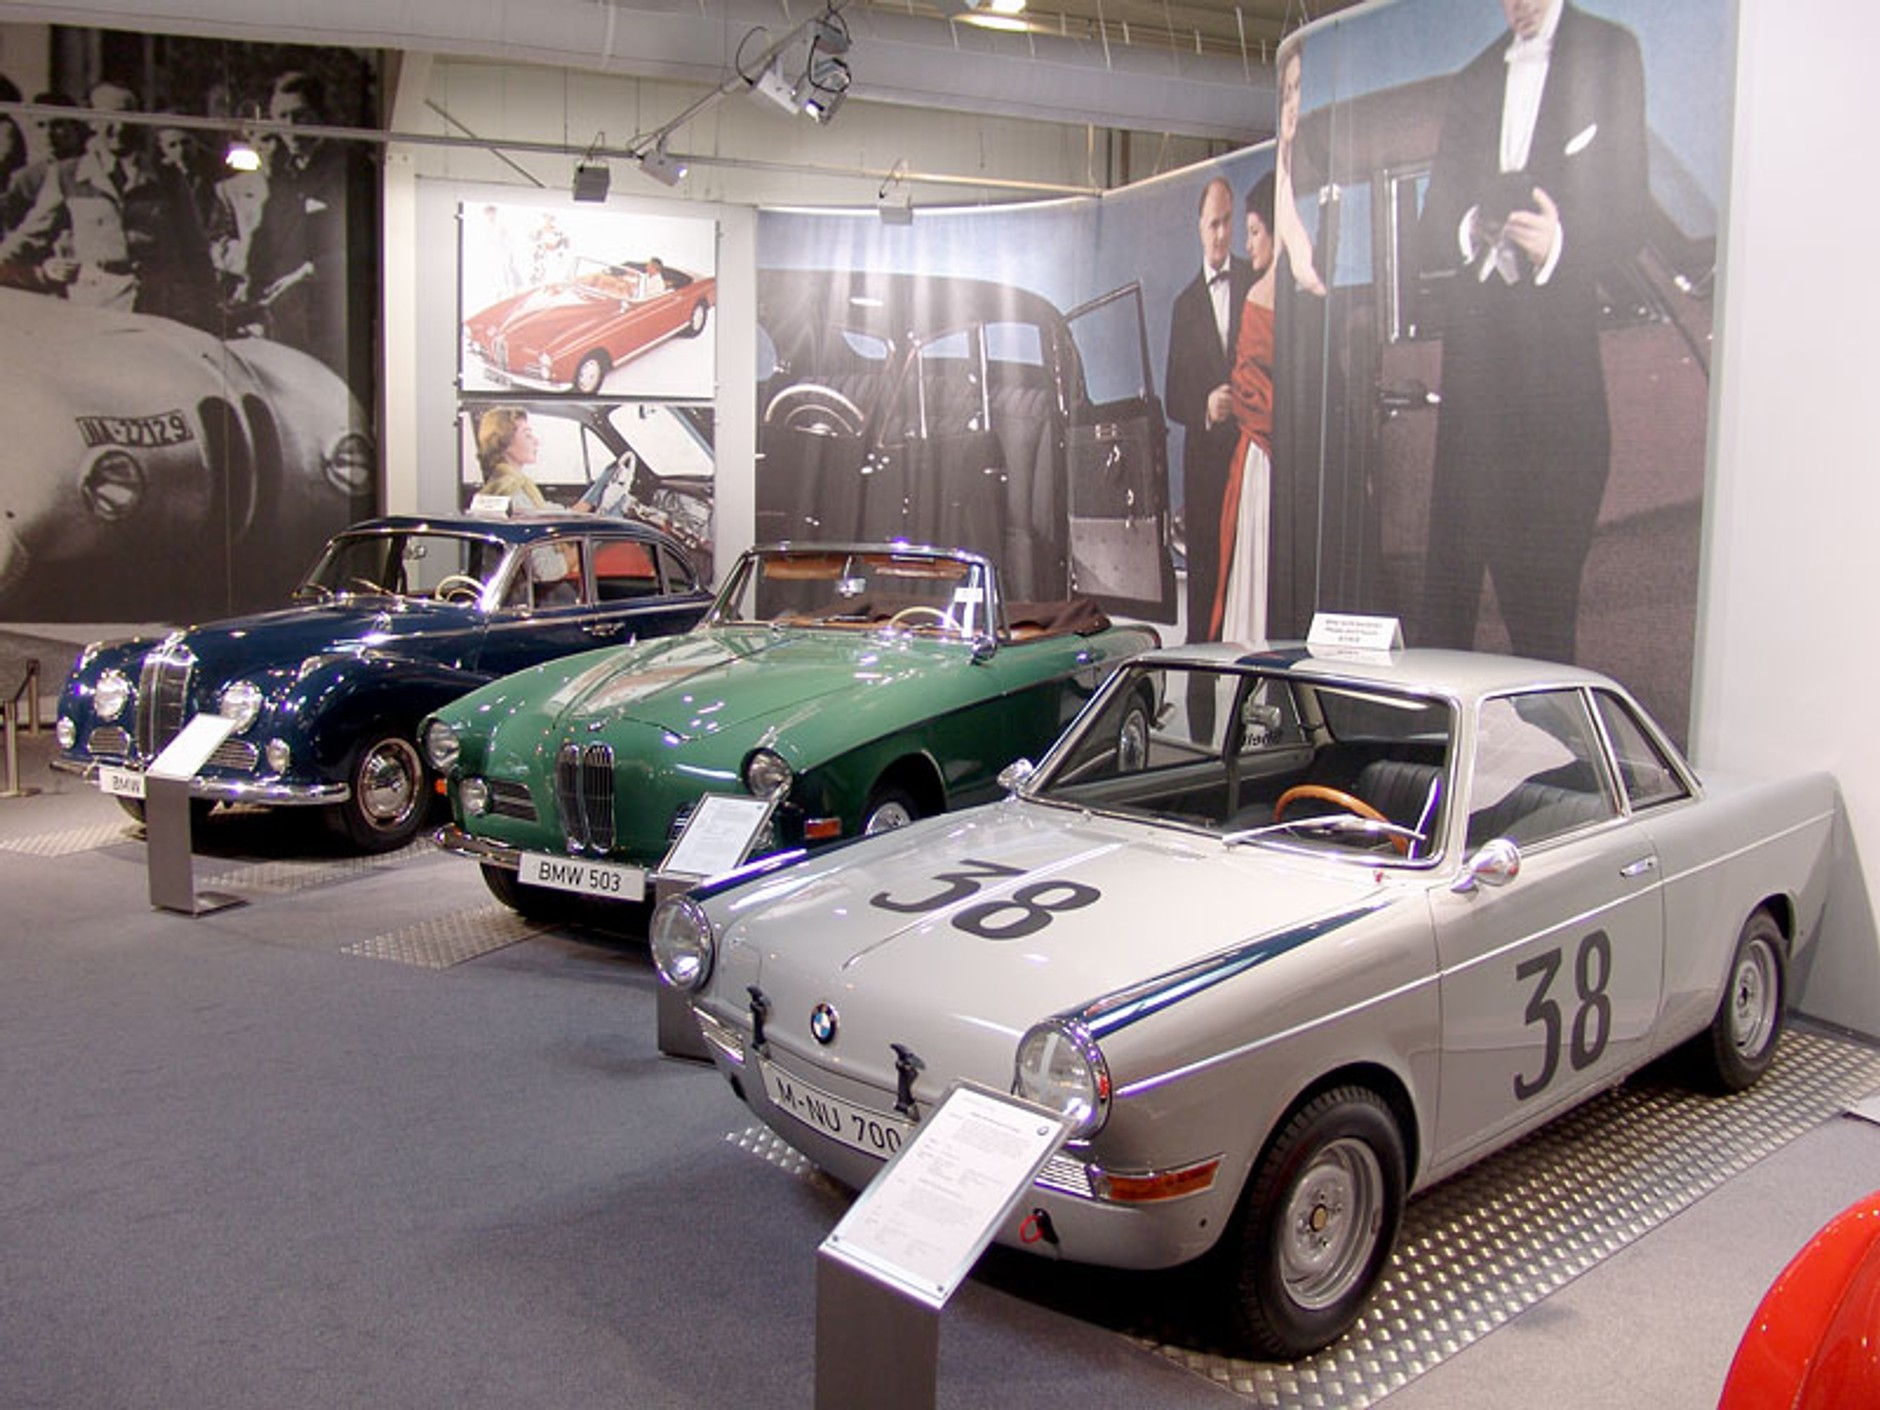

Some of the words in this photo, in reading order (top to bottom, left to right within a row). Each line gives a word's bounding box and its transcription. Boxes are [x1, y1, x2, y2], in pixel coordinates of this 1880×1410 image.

[539, 862, 584, 886] BMW
[589, 869, 622, 892] 503
[869, 859, 1101, 940] 38
[1514, 929, 1612, 1101] 38
[775, 1076, 841, 1132] M-NU
[851, 1113, 902, 1153] 700
